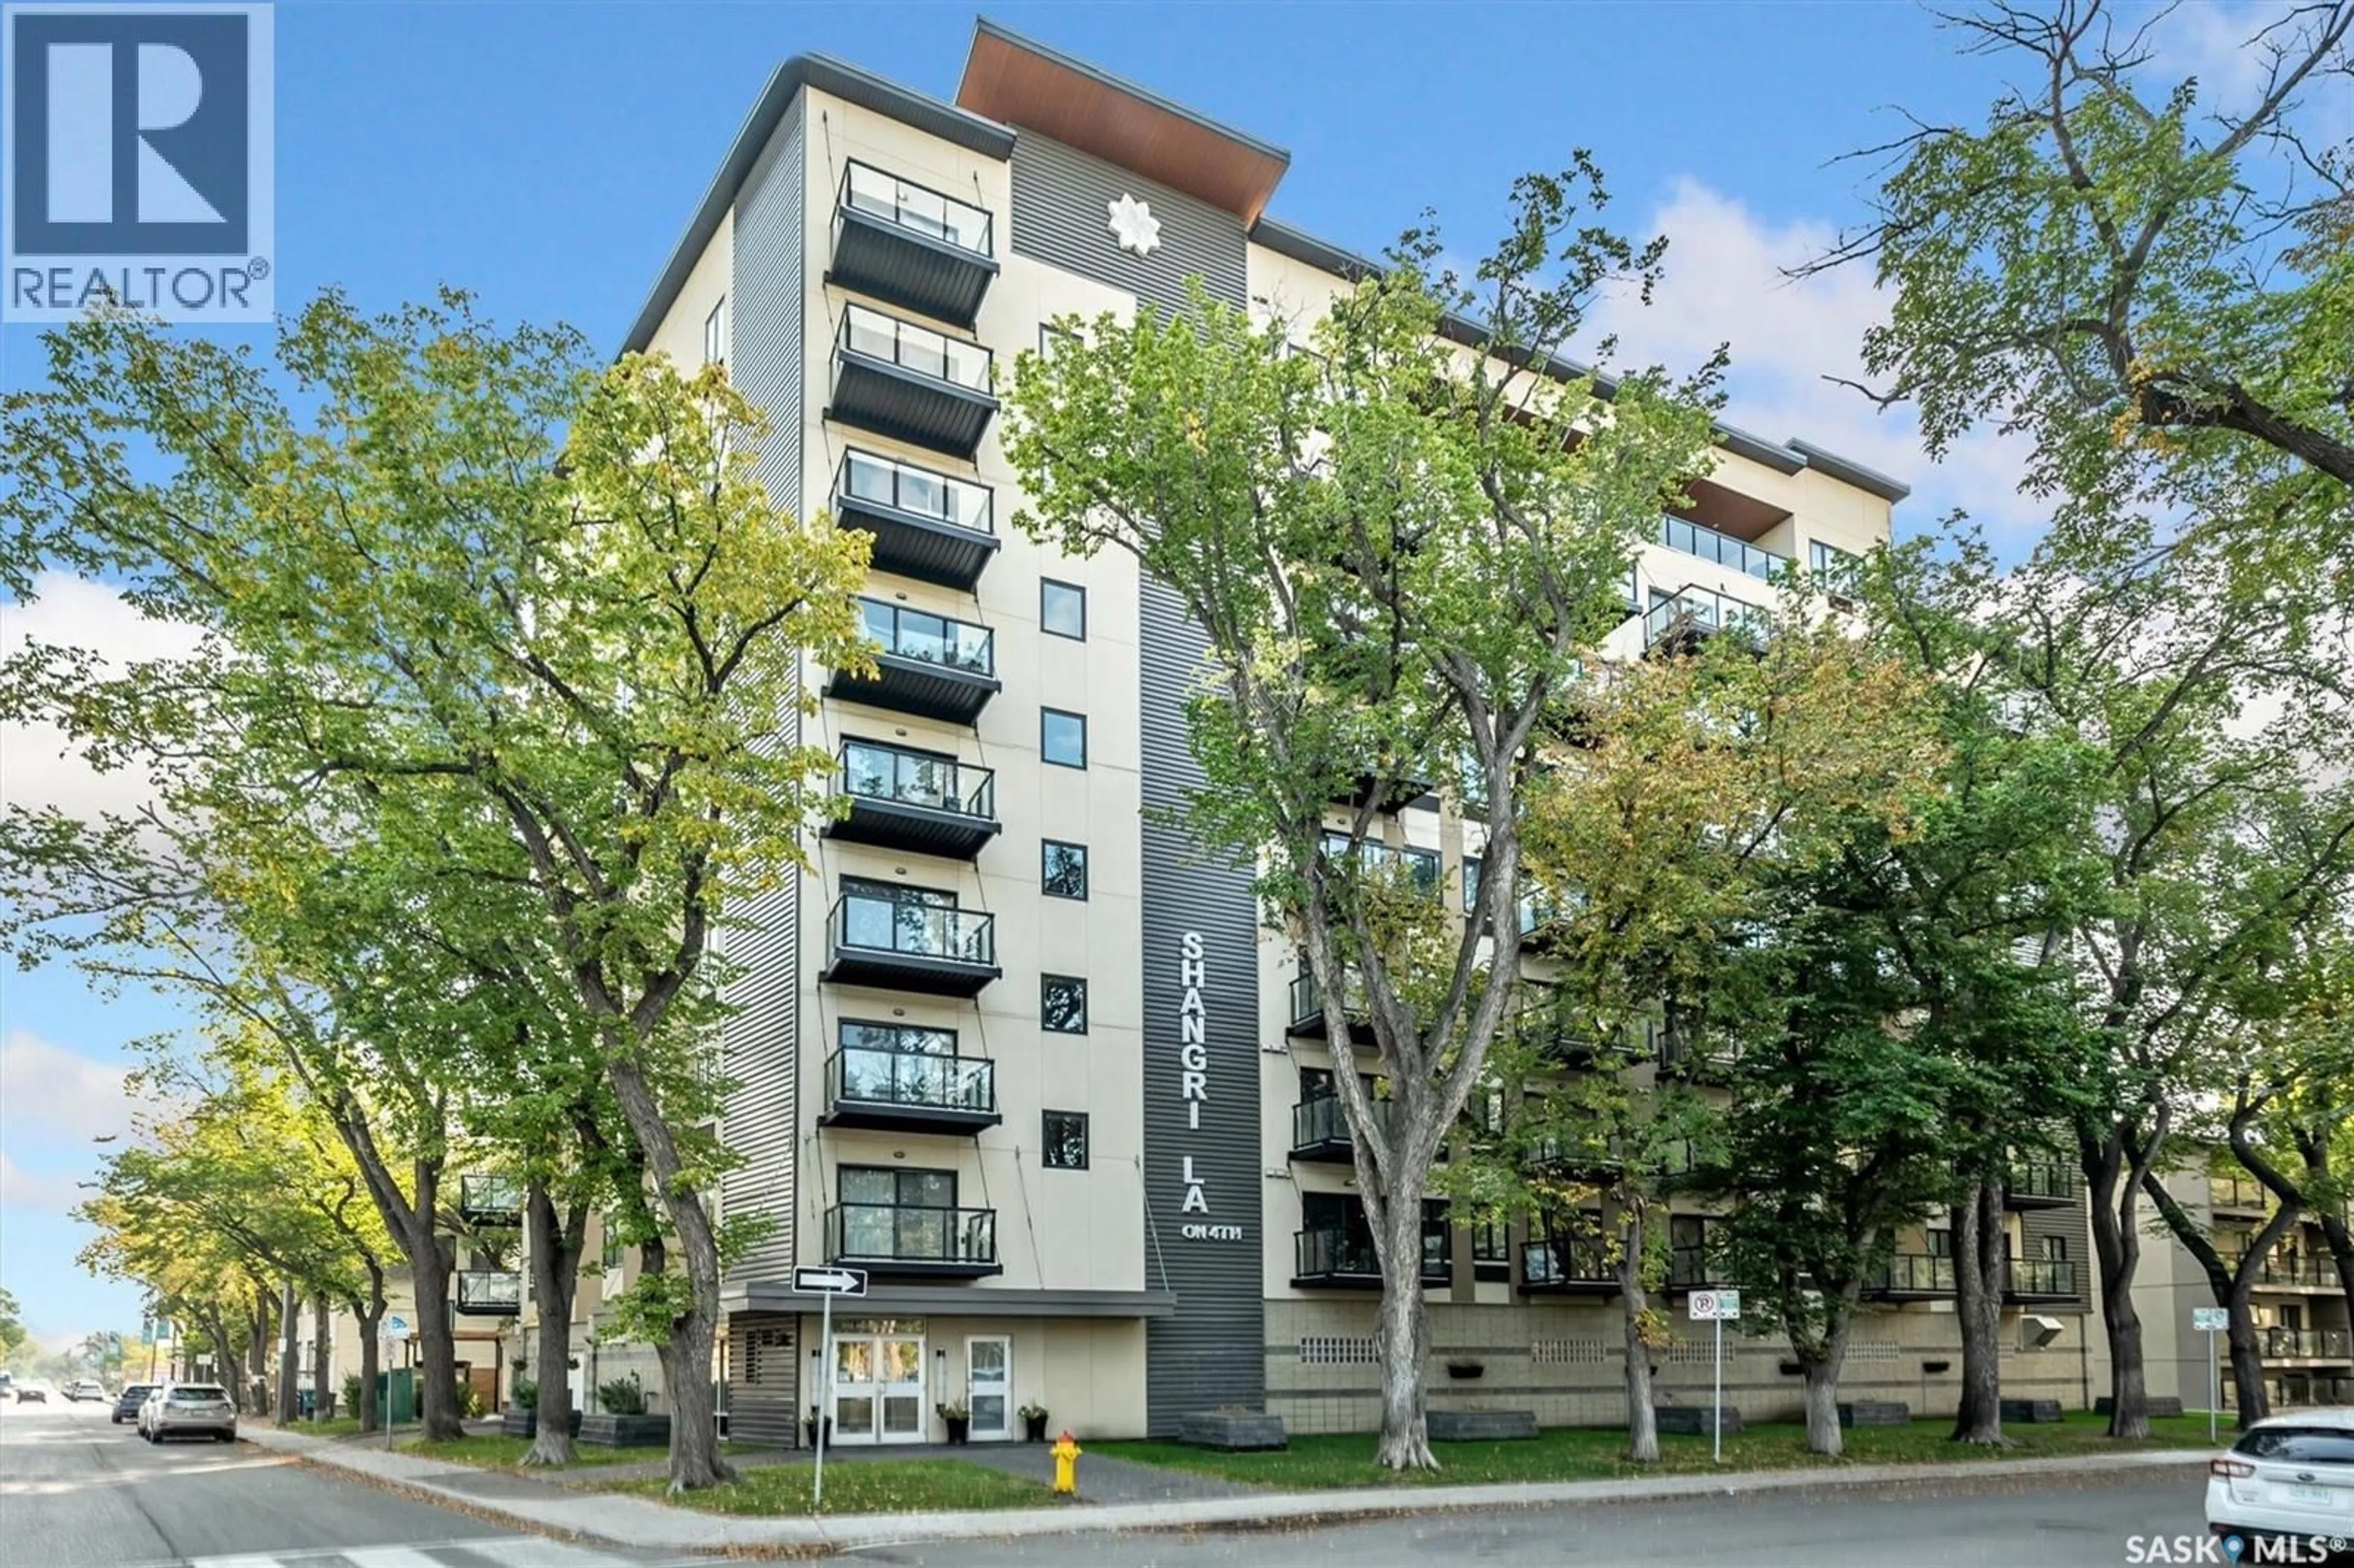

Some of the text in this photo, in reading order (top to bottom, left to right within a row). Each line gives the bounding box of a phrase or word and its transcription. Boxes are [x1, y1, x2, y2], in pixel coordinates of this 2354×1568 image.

[1181, 932, 1208, 1213] SHANGRI LA
[1181, 1224, 1242, 1239] ON 4TH
